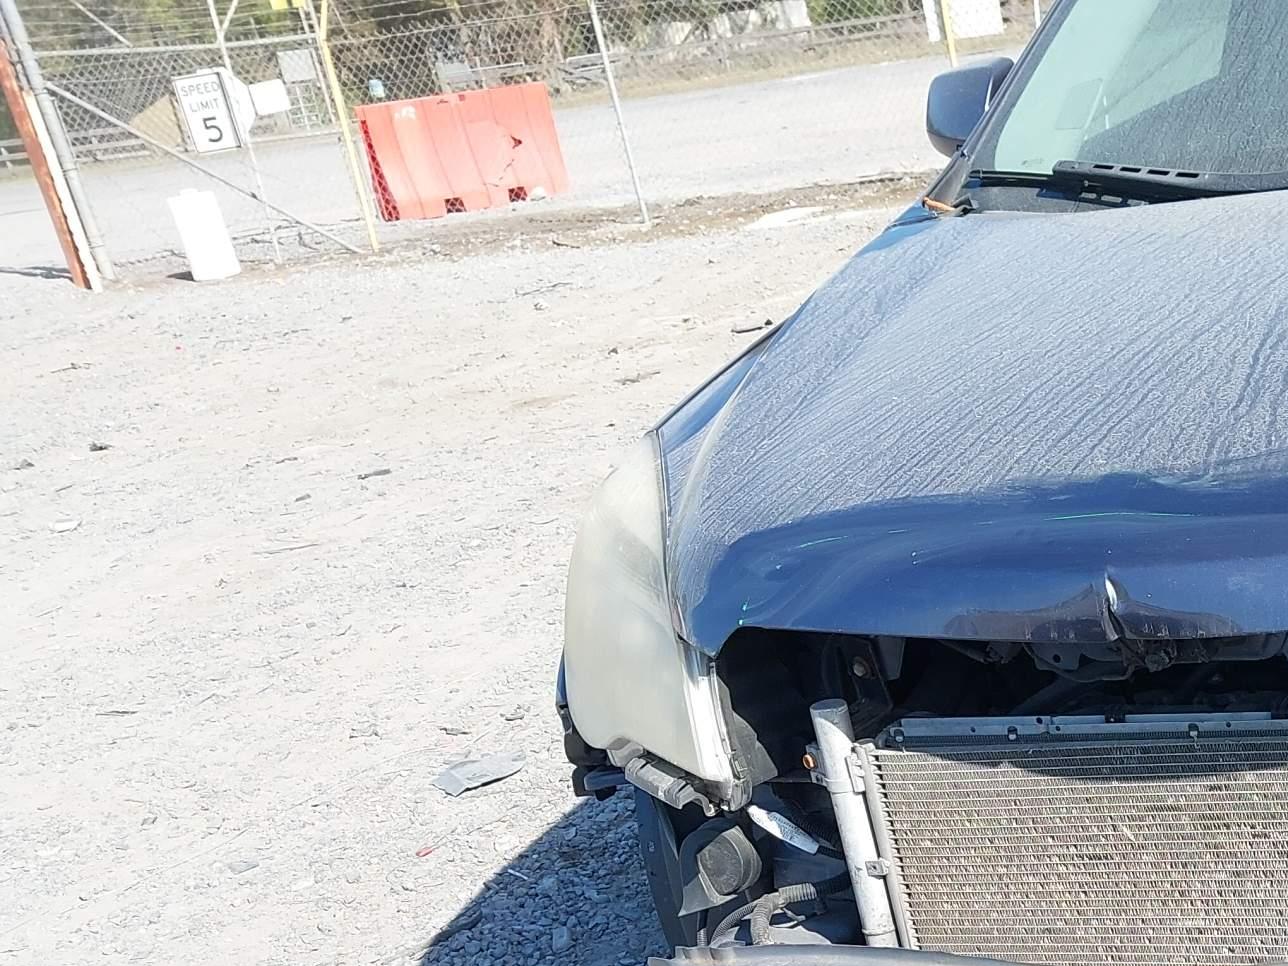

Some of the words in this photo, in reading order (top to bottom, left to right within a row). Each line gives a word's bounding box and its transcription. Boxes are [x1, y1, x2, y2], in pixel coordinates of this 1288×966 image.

[180, 81, 220, 97] SPEED
[189, 98, 220, 112] LIMIT
[202, 116, 223, 142] 5
